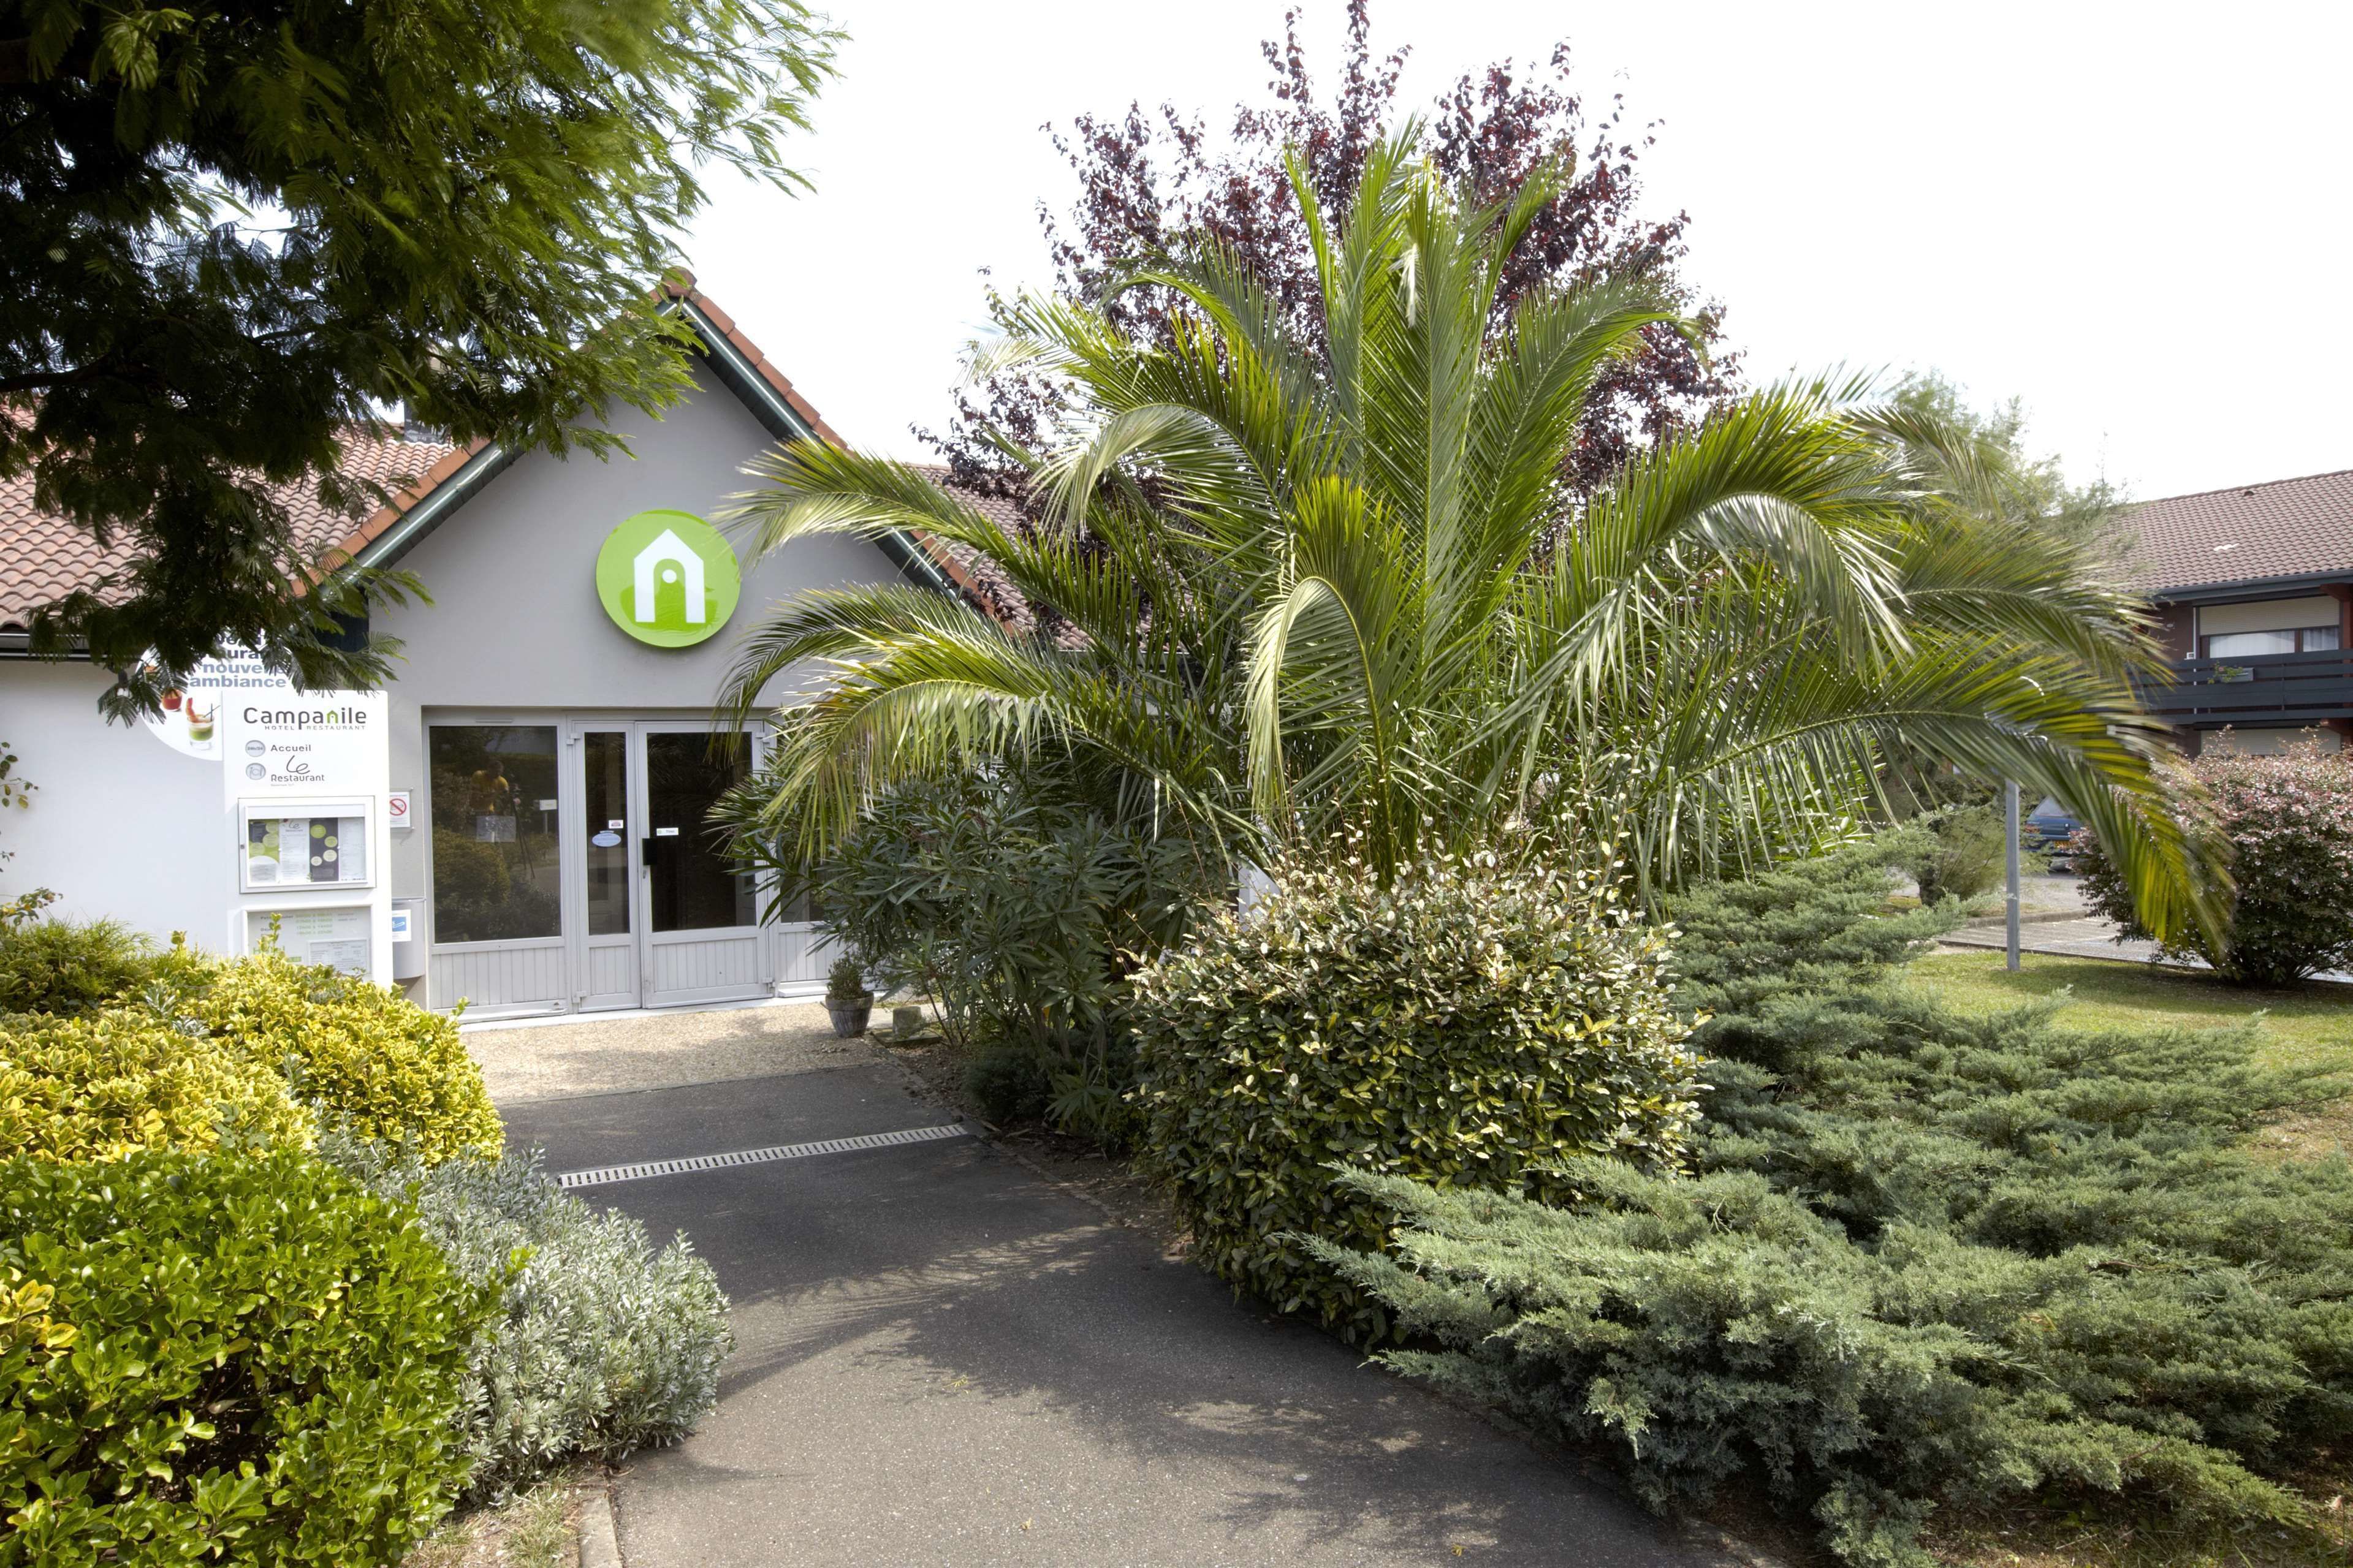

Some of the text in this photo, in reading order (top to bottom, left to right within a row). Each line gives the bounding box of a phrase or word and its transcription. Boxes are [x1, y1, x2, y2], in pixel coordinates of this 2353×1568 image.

[203, 661, 284, 674] nouvee
[189, 675, 287, 687] ambiance
[243, 707, 367, 730] Campanile
[286, 754, 311, 775] Le
